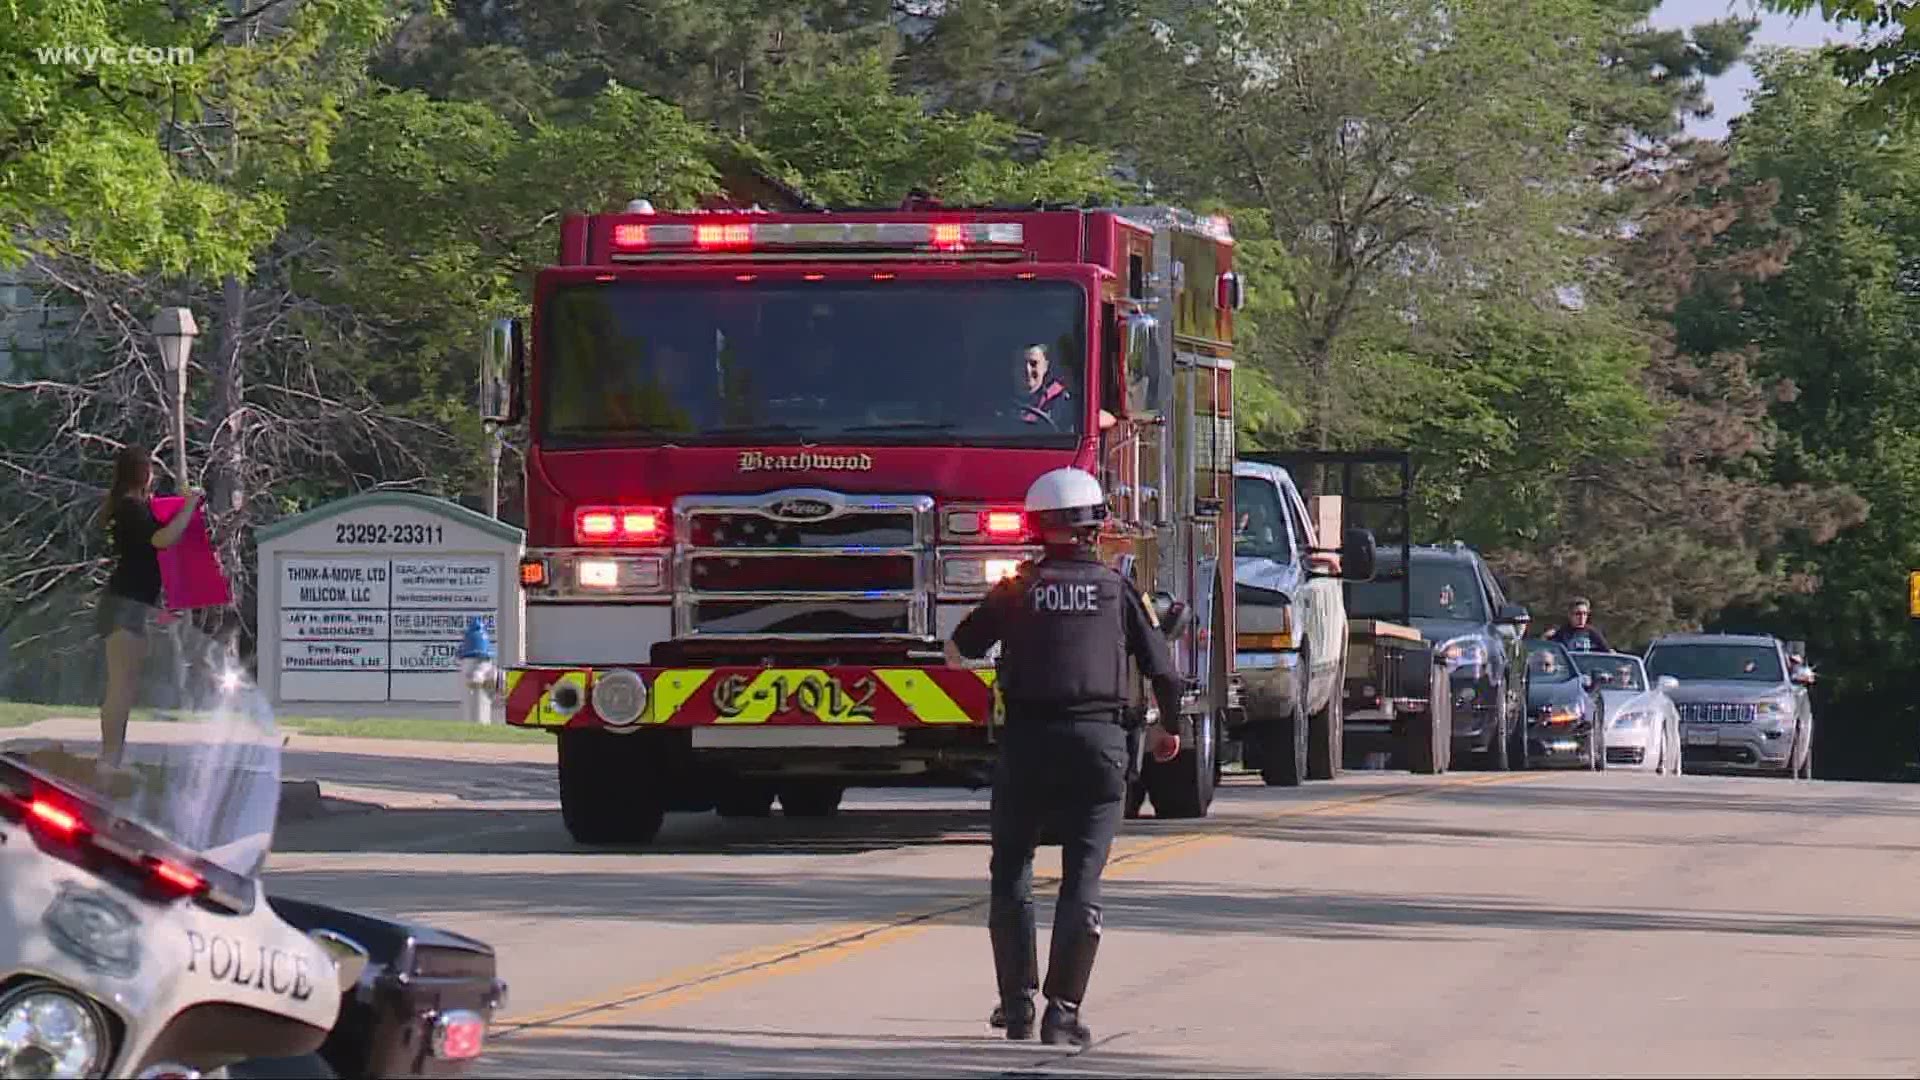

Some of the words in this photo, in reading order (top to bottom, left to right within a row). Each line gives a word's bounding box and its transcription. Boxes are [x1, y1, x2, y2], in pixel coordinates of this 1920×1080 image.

[739, 451, 873, 472] Beachwood
[335, 524, 443, 545] 23292-23311
[367, 567, 386, 581] LTD
[351, 587, 371, 602] LLC
[1035, 584, 1098, 611] POLICE
[394, 615, 412, 626] THE
[713, 674, 877, 717] E-1012
[187, 929, 314, 1001] POLICE
